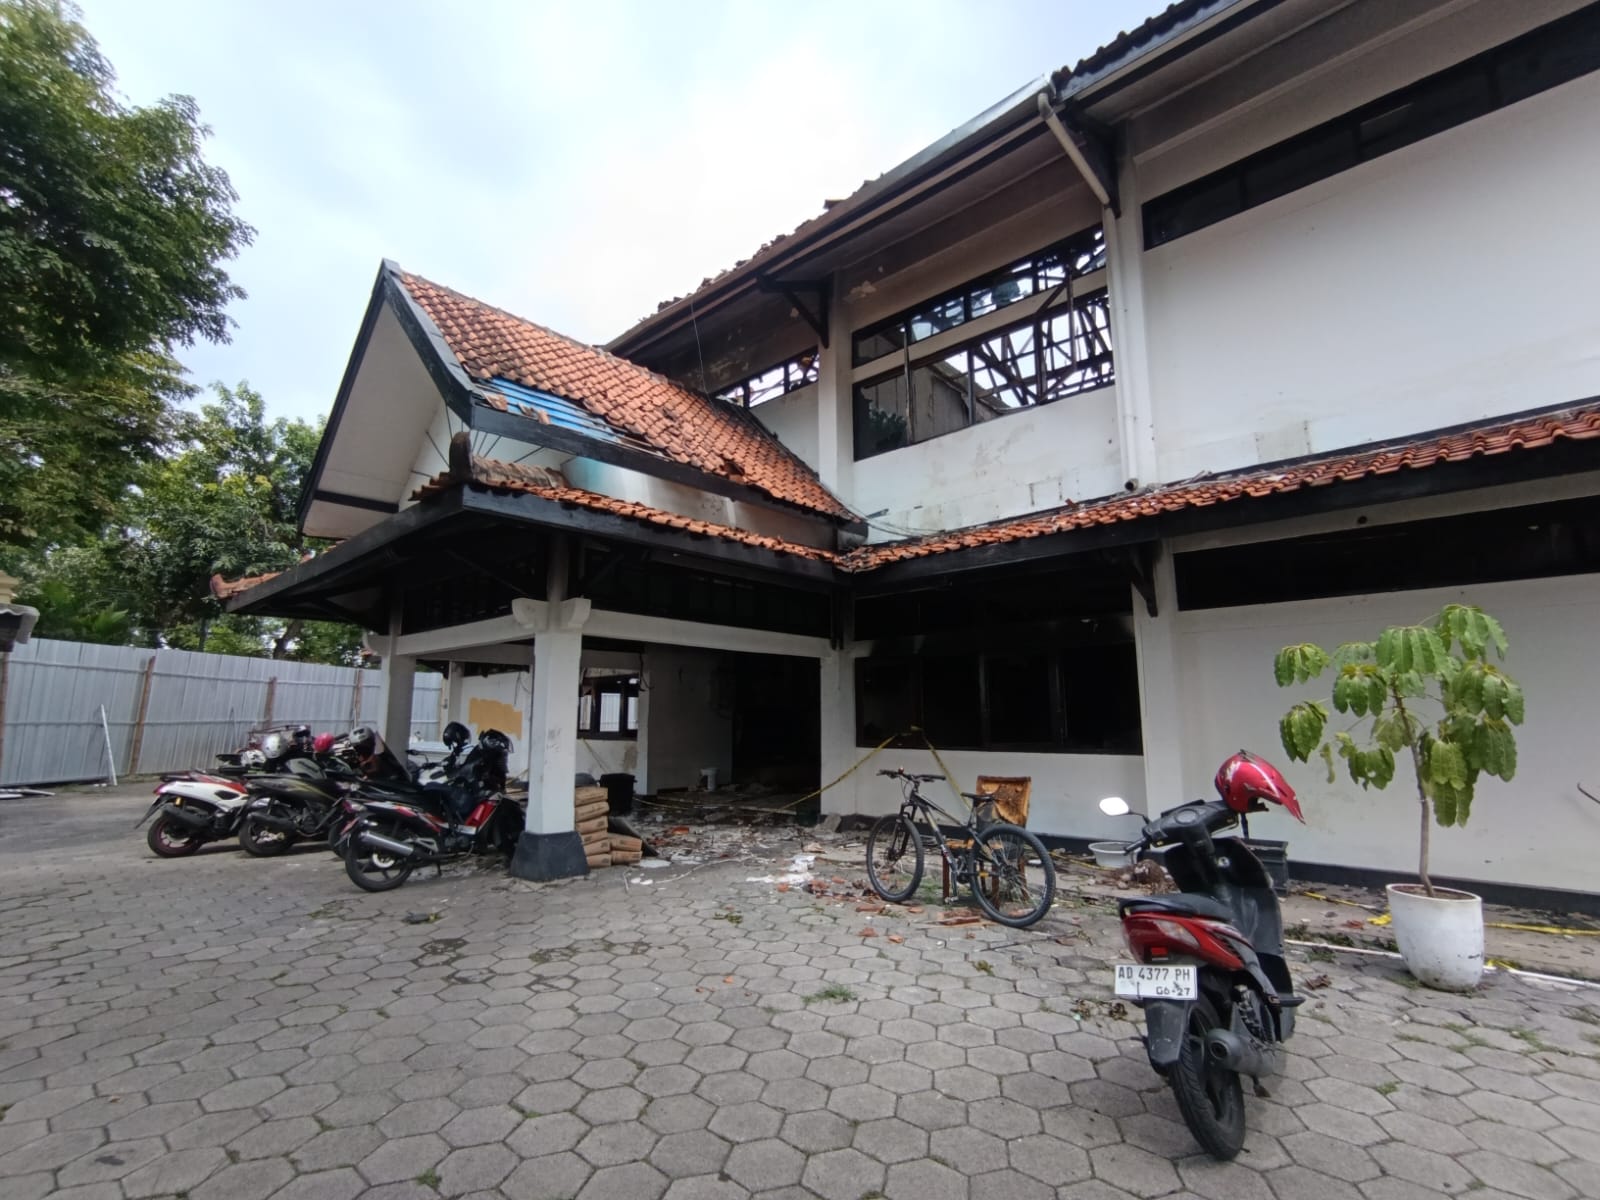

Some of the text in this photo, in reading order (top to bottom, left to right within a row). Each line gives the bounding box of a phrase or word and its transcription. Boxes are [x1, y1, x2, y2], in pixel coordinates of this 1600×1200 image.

[1118, 966, 1190, 981] AD 4377 PH
